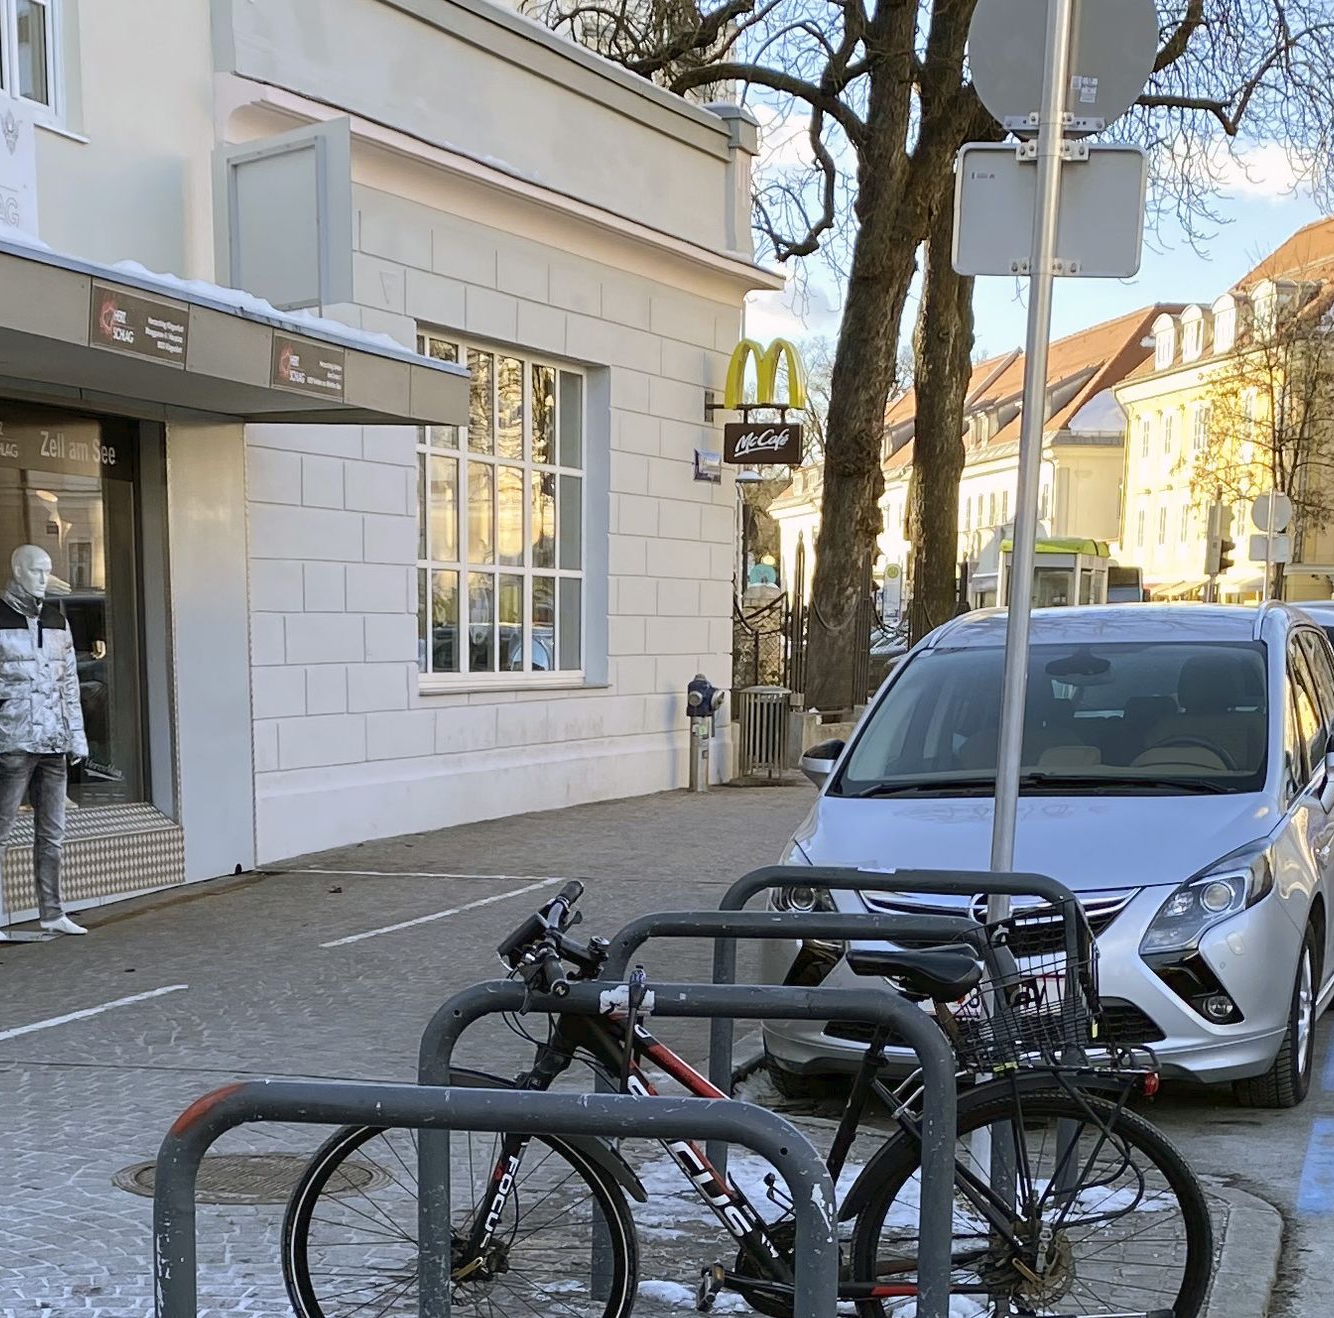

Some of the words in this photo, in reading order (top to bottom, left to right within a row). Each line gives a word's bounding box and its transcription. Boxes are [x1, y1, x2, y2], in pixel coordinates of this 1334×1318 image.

[40, 430, 66, 459] Zell
[69, 442, 89, 461] am
[92, 438, 117, 466] See
[479, 1154, 520, 1249] FOCUS
